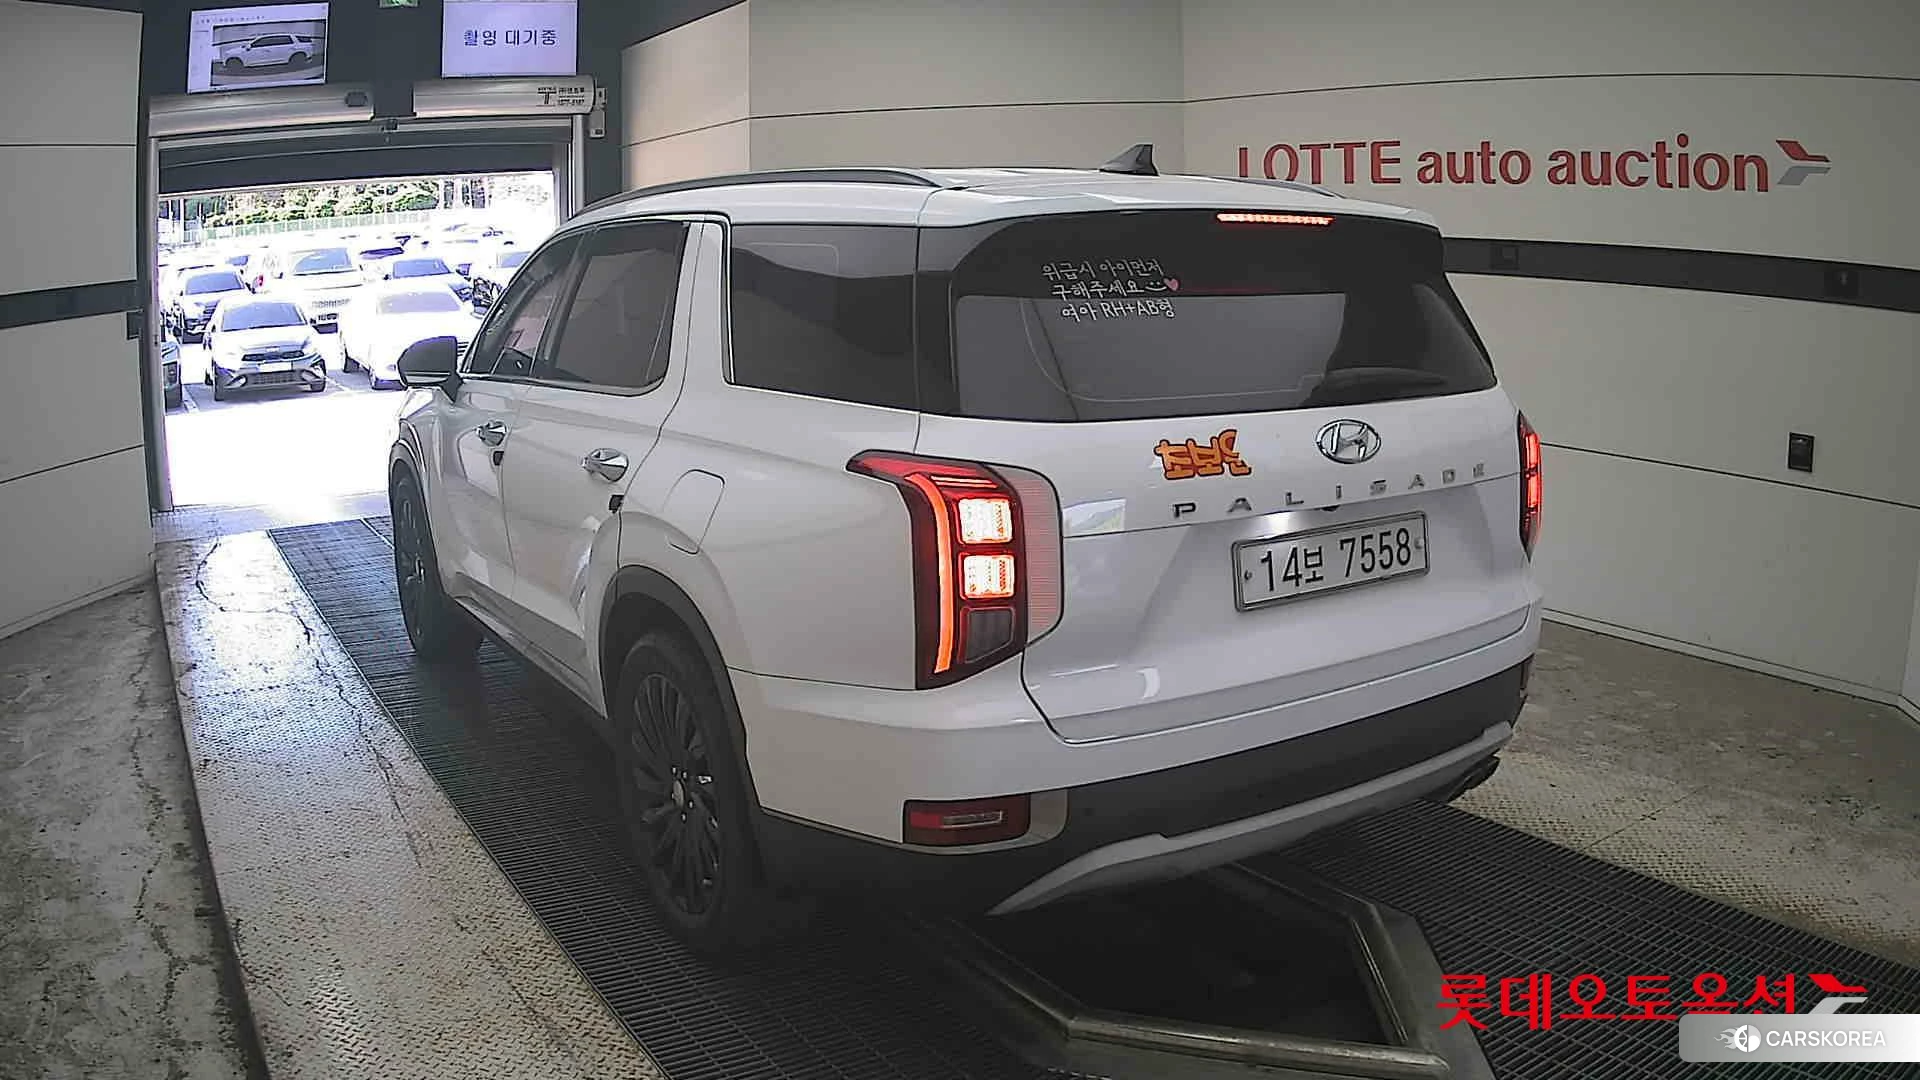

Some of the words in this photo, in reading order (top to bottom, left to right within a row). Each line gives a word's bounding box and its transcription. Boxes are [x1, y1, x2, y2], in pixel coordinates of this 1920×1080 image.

[505, 29, 557, 46] 대기중
[1416, 141, 1531, 185] auto
[1547, 134, 1769, 193] auction
[1042, 260, 1096, 281] 위급시
[1052, 280, 1145, 301] 구해주세요
[1062, 303, 1098, 322] 여아
[1100, 298, 1175, 318] RH+AB형
[1173, 462, 1485, 519] PALISADE
[1340, 527, 1411, 578] 7558
